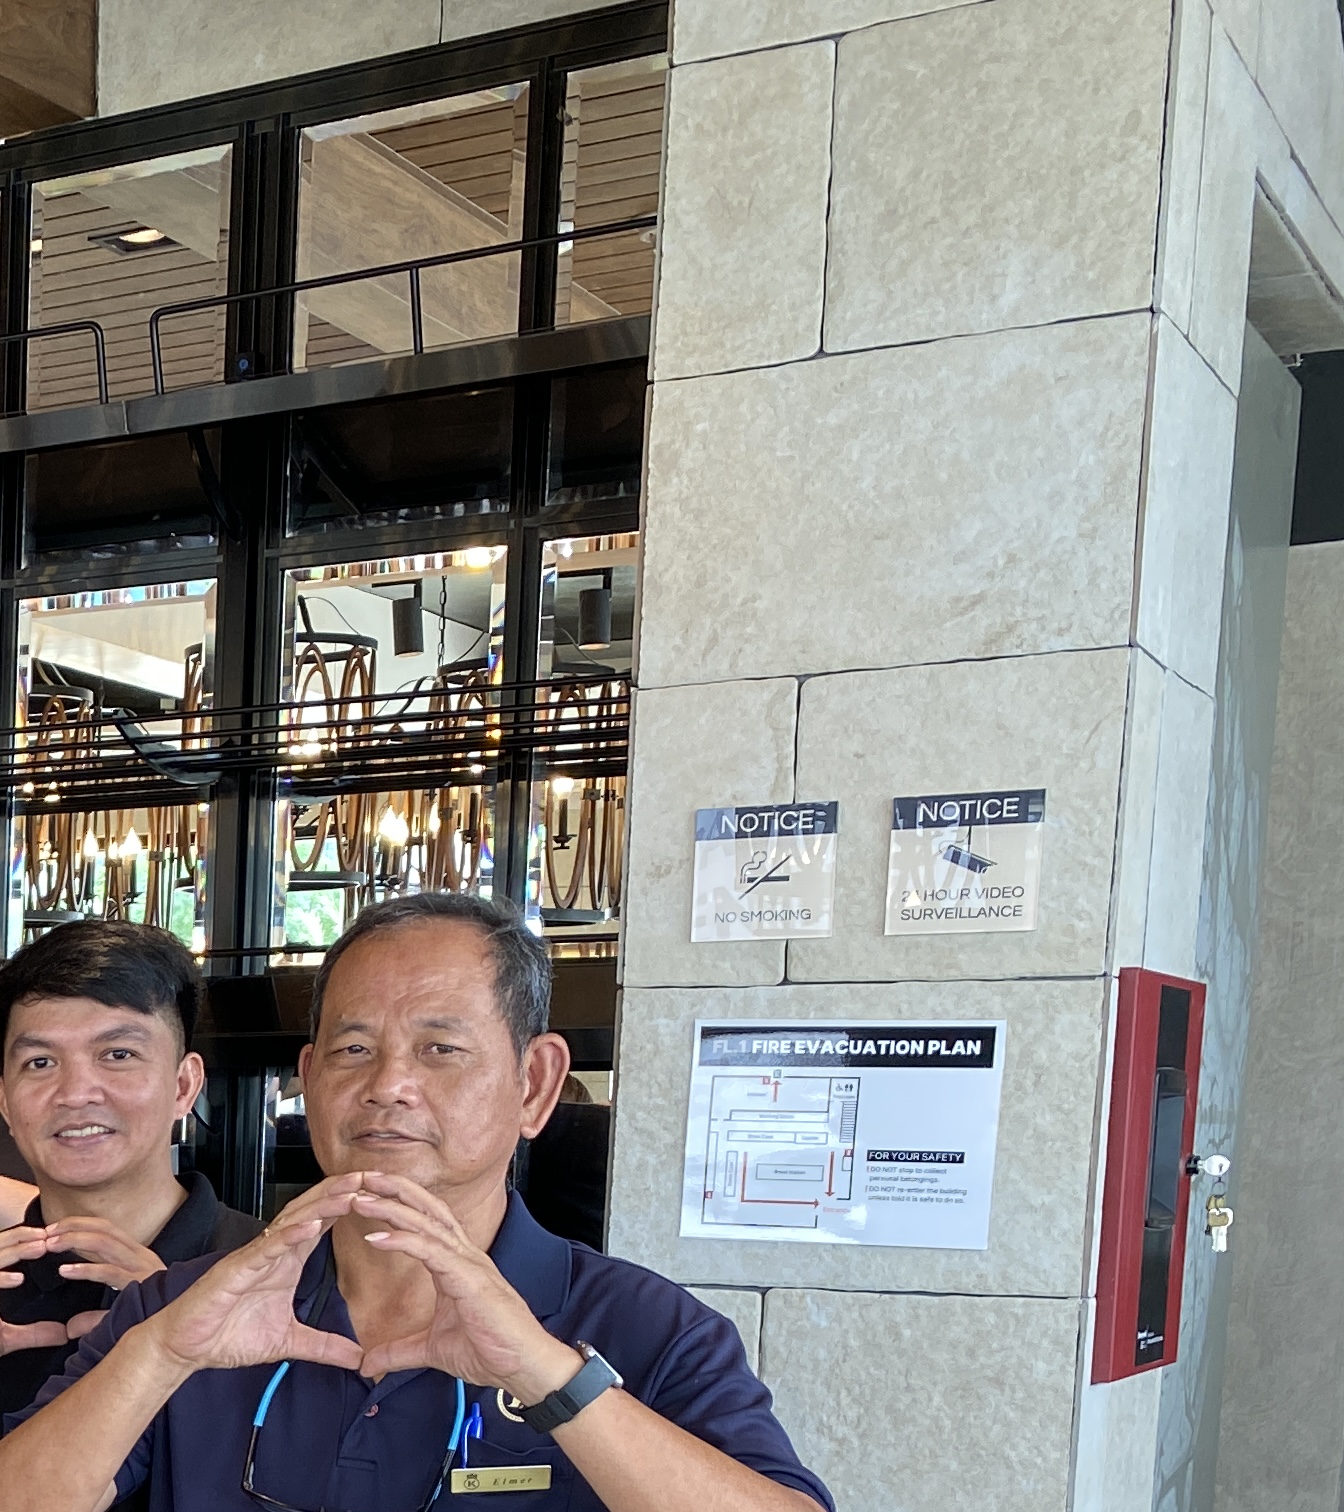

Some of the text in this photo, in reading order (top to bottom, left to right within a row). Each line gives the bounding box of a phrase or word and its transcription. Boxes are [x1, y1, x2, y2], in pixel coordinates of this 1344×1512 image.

[918, 797, 1020, 822] NOTICE
[721, 809, 815, 834] NOTICE
[923, 887, 971, 902] HOUR
[974, 885, 1025, 900] VIDEO
[714, 908, 812, 924] NO SMOKING
[900, 904, 1024, 921] SURVEILLANCE
[712, 1038, 981, 1055] FL.1 FIRE EVACUATION PLAN
[868, 1151, 961, 1161] FOR YOUR SAFETY
